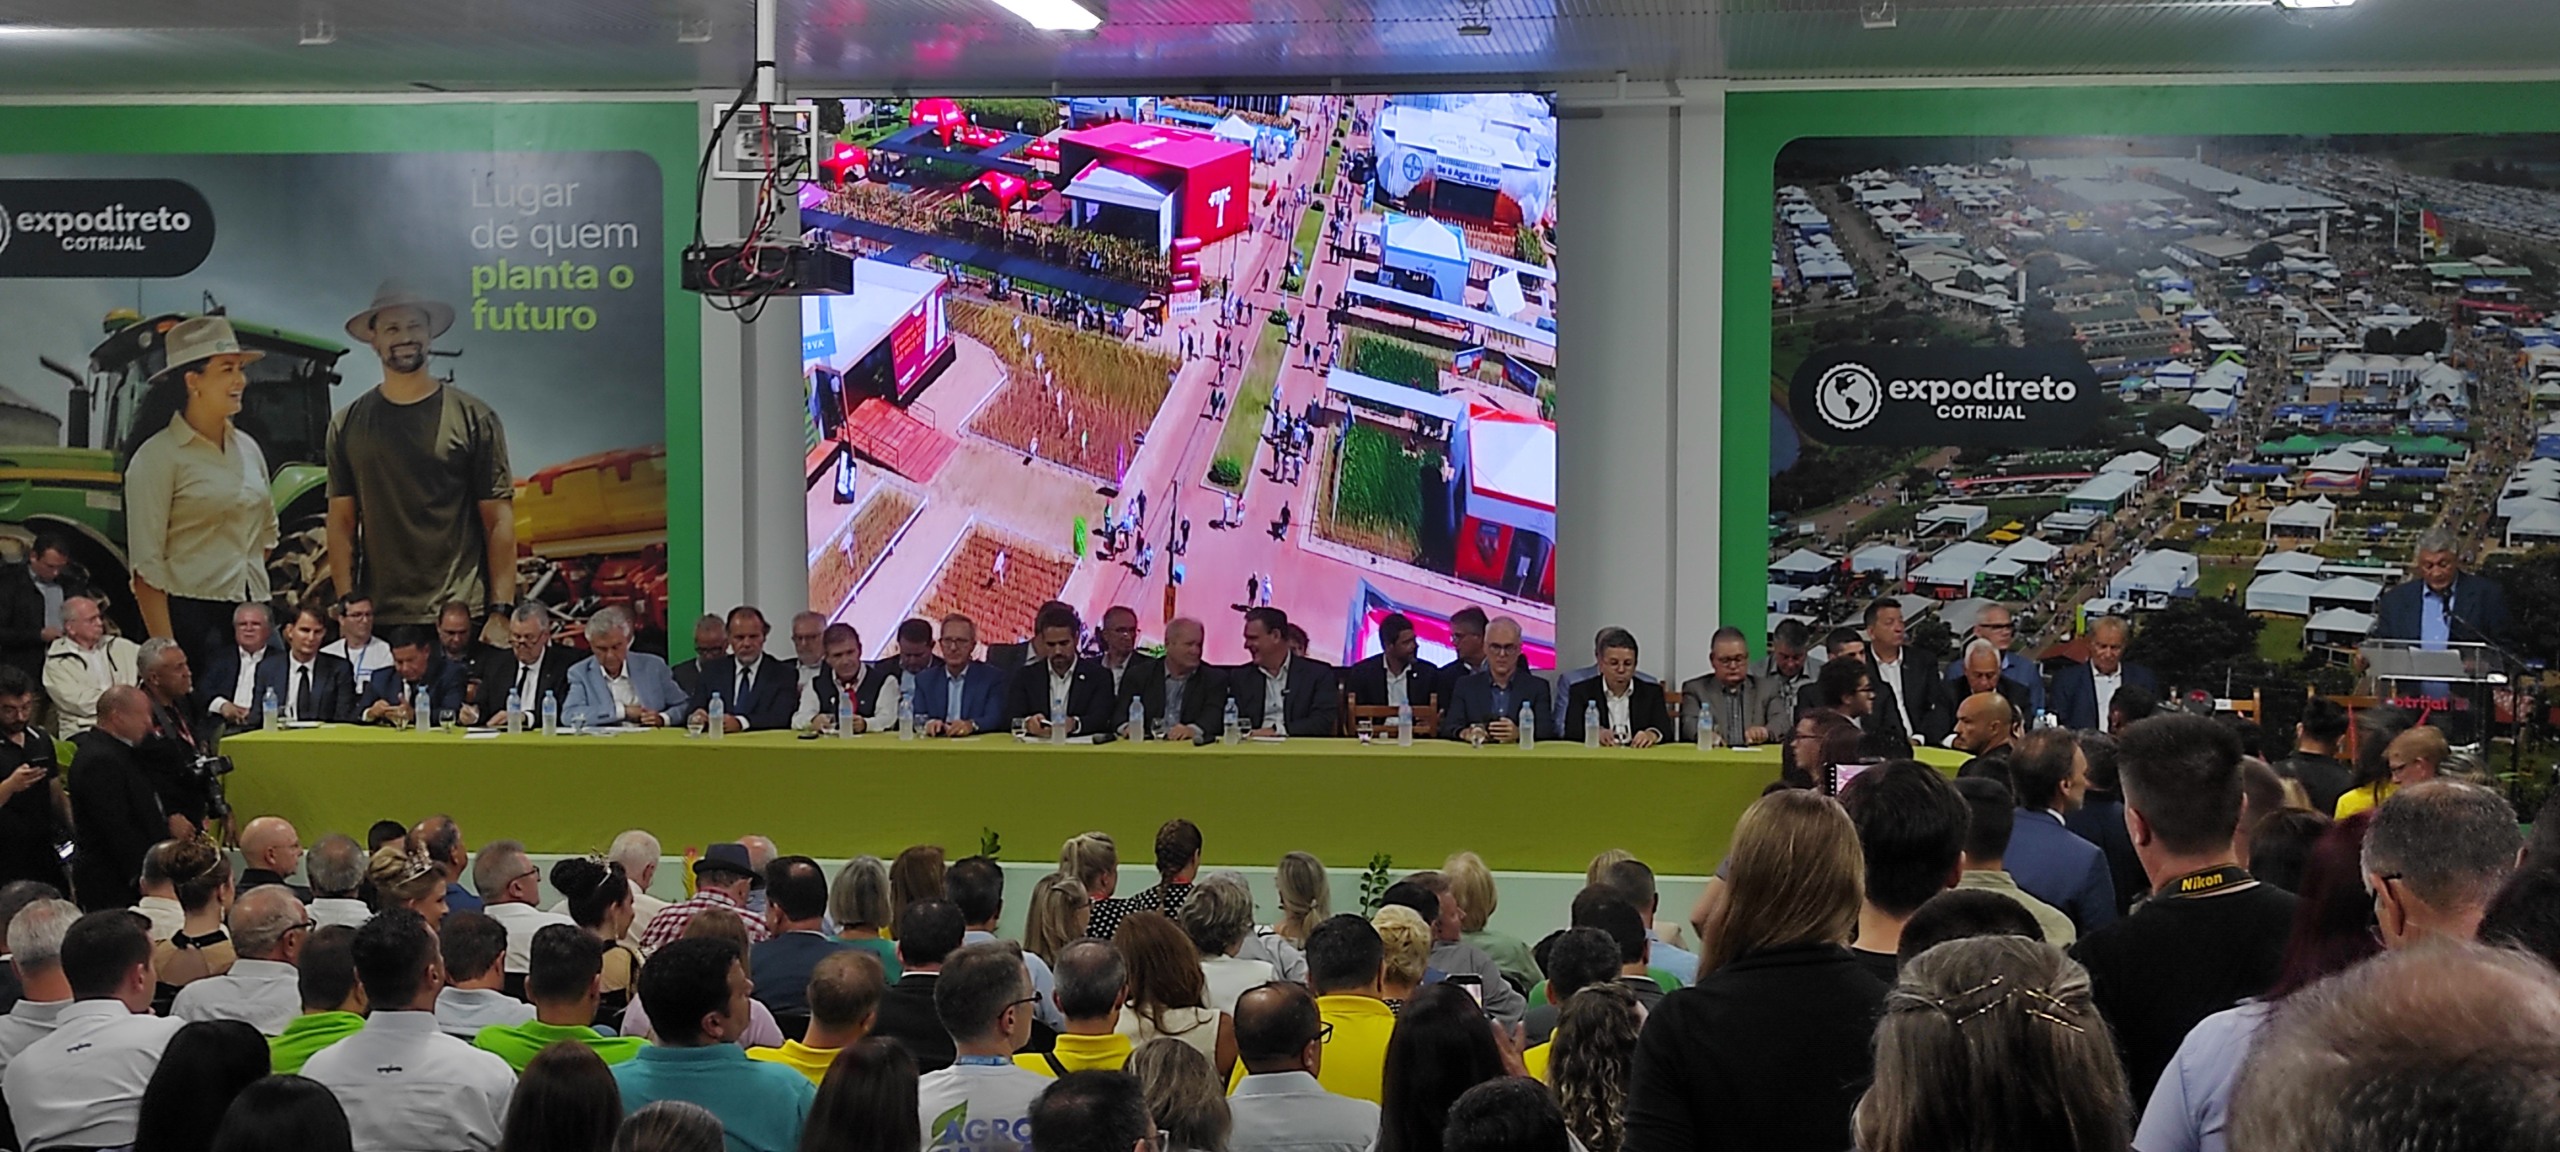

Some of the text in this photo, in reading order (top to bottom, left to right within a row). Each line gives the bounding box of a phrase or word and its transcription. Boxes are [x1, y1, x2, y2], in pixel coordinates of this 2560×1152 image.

[471, 177, 580, 216] Lugar
[16, 203, 192, 238] expodireto
[61, 236, 146, 251] COTRIJAL
[470, 219, 638, 257] de quem
[471, 258, 635, 298] planta o
[471, 298, 598, 331] futuro
[1888, 371, 2077, 406] expodireto
[1936, 404, 2027, 420] COTRIJAL
[2181, 873, 2223, 891] Nikon
[942, 1117, 1033, 1144] AGRO
